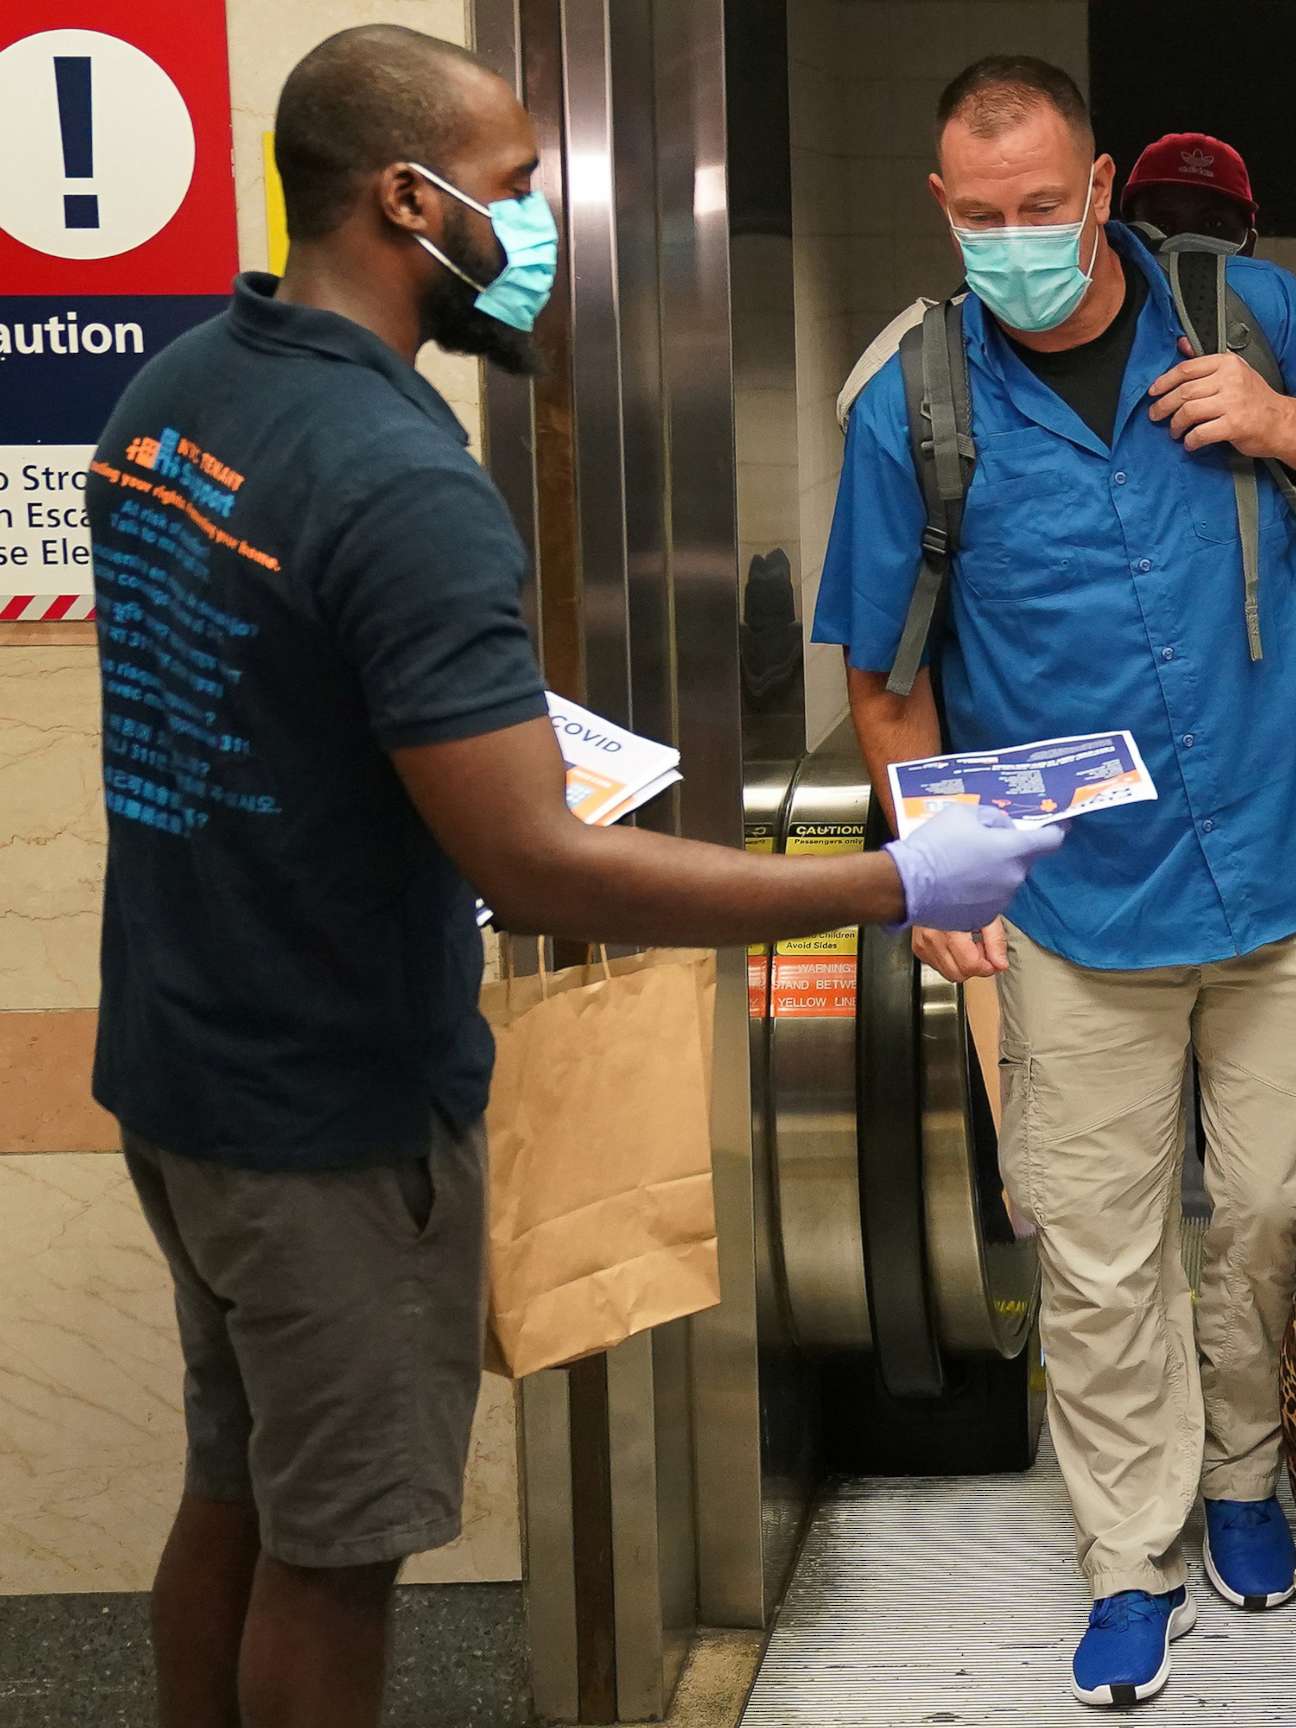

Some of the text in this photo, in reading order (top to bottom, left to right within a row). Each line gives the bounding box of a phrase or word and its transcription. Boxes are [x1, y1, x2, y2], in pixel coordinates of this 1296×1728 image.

[22, 464, 88, 491] Stro
[42, 538, 90, 566] Ele
[550, 715, 622, 752] COVID
[796, 825, 864, 836] CAUTION
[794, 838, 863, 847] Passengers only
[778, 997, 827, 1007] YELLOW
